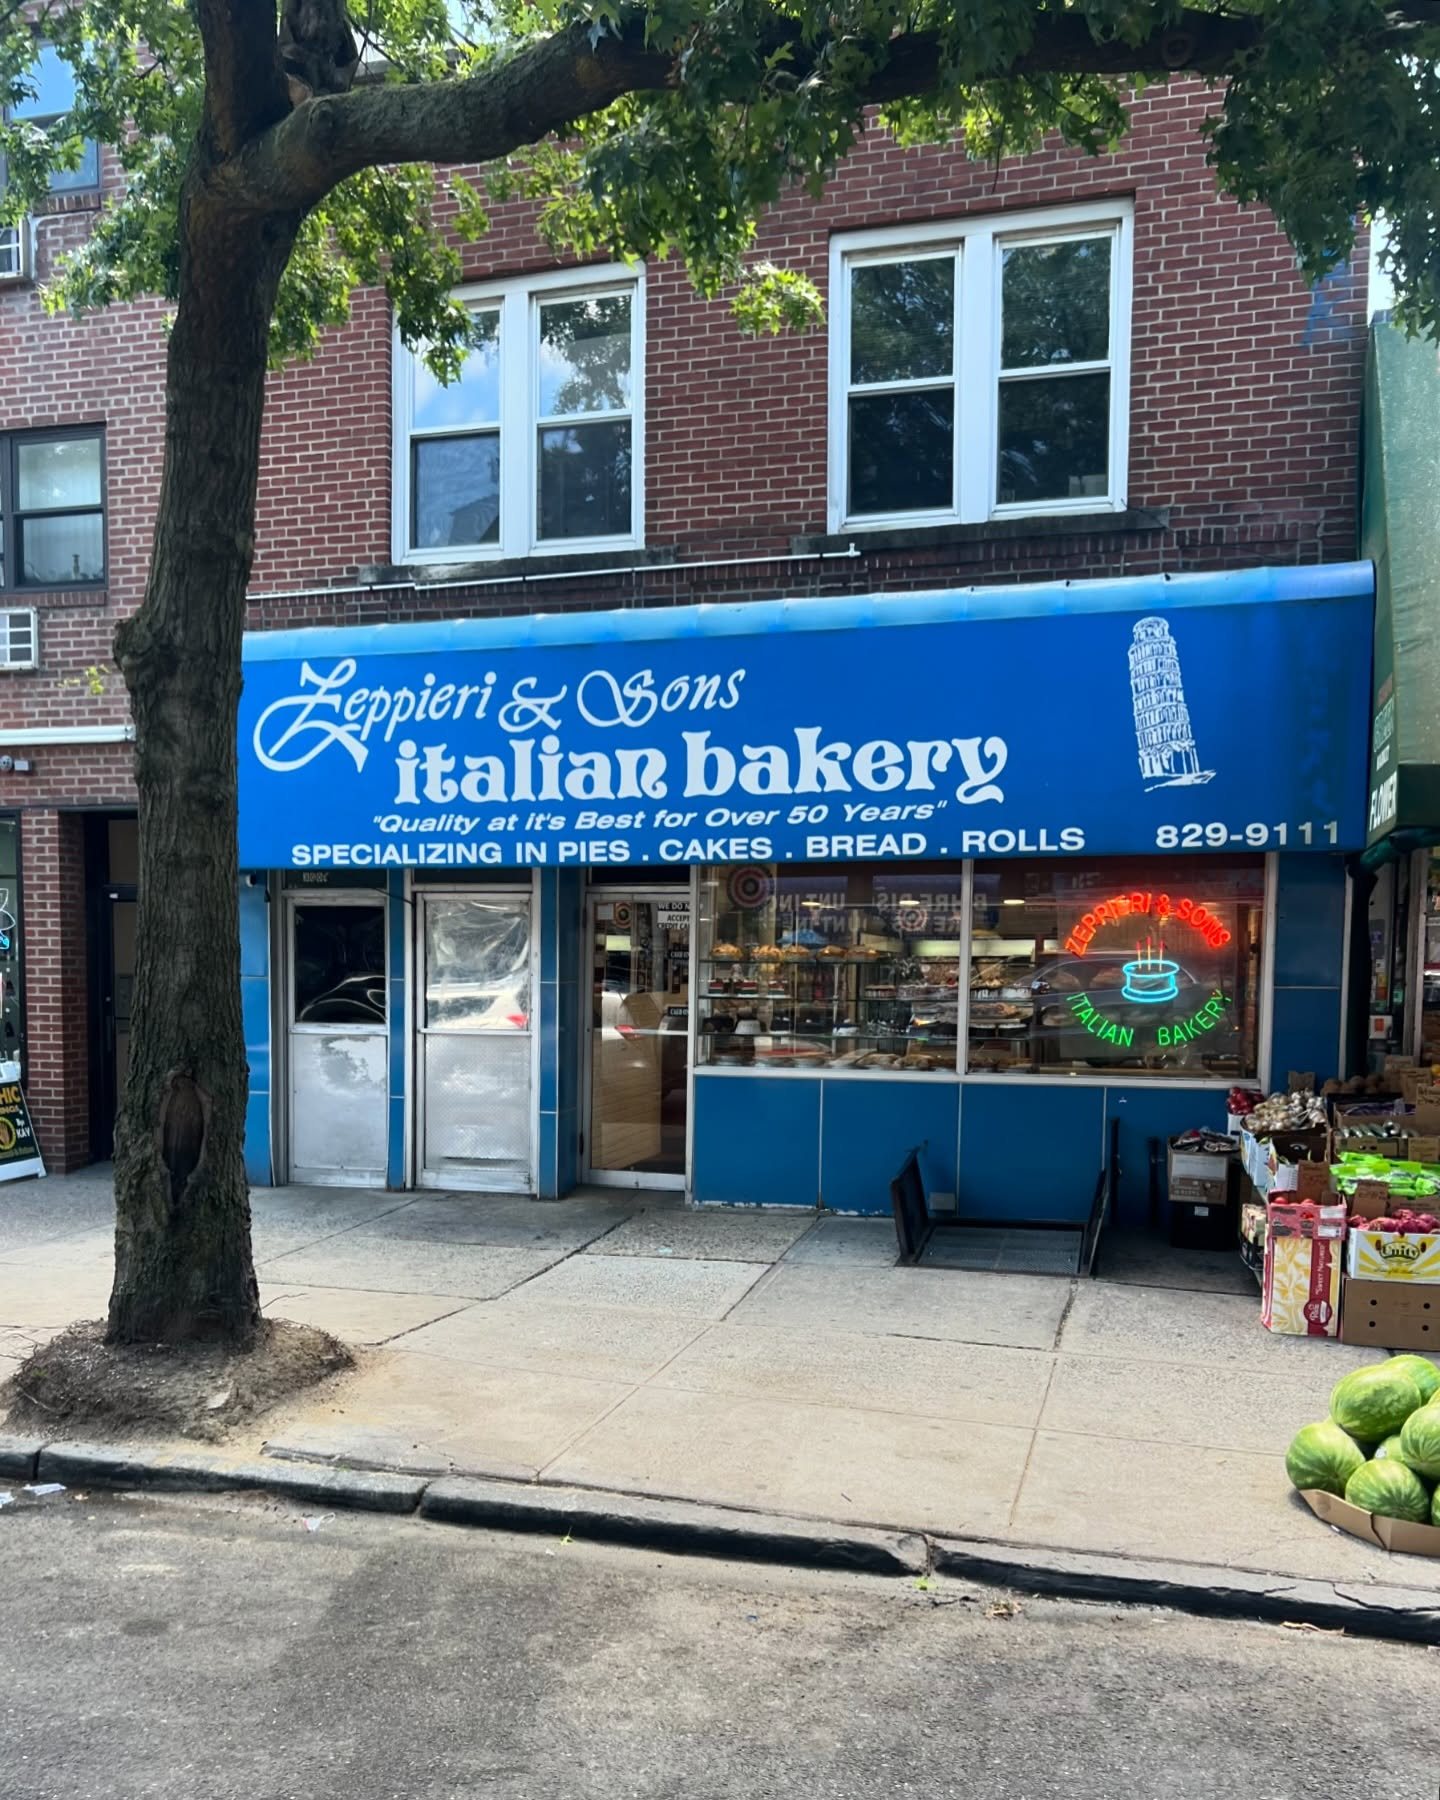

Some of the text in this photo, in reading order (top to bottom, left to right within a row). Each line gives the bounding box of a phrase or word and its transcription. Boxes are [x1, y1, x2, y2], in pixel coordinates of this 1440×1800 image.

[253, 658, 746, 773] Zeppieri & Sons
[393, 726, 1009, 805] italian bakery
[373, 800, 949, 836] "Quality at it's Best for Over 50 Years"
[1155, 820, 1339, 849] 829-9111
[291, 827, 1086, 866] SPECIALIZING IN PIES CAKES BREAD ROLLS
[1176, 898, 1232, 949] SONS
[1066, 987, 1232, 1048] ITALIAN BAKERY
